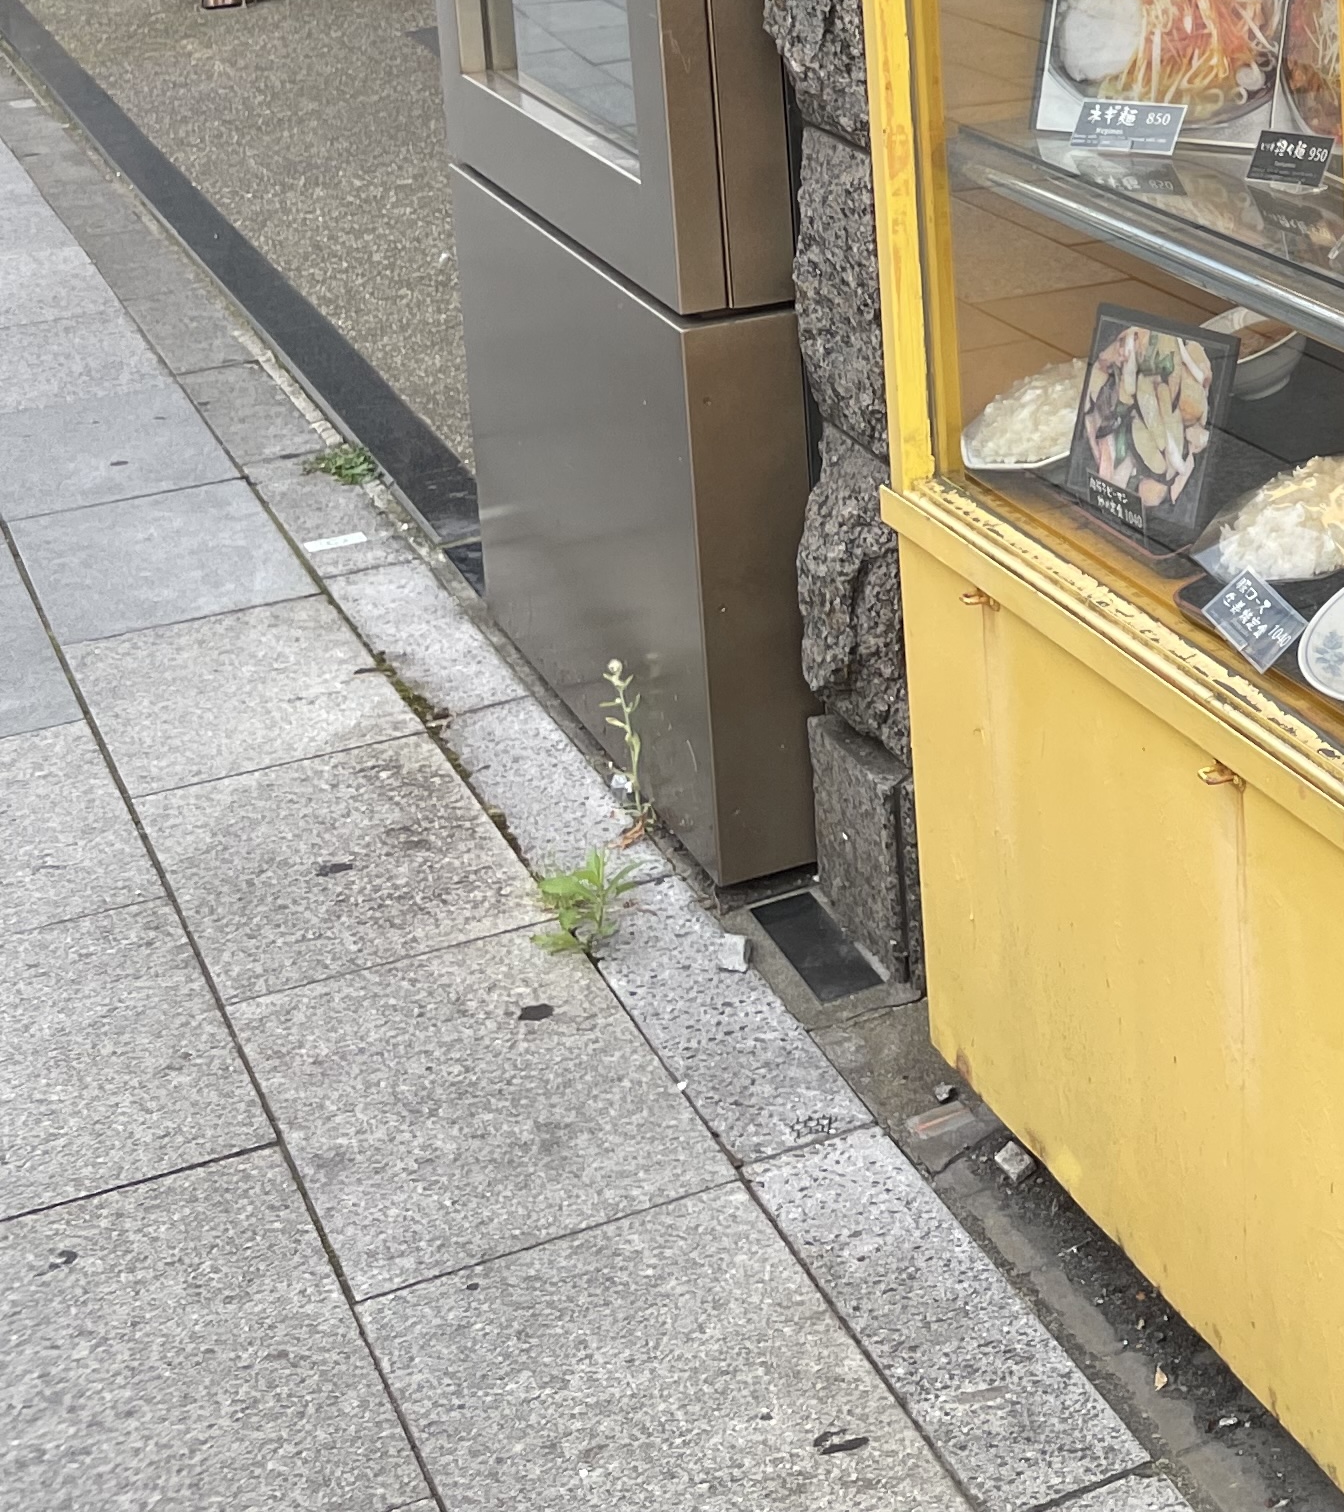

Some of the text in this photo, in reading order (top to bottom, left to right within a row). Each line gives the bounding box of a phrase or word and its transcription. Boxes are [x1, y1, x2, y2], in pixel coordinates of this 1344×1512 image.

[1087, 104, 1171, 126] ネギ麺 850
[1308, 147, 1328, 163] 950
[1124, 510, 1143, 529] 1040
[1268, 624, 1292, 648] 1040
